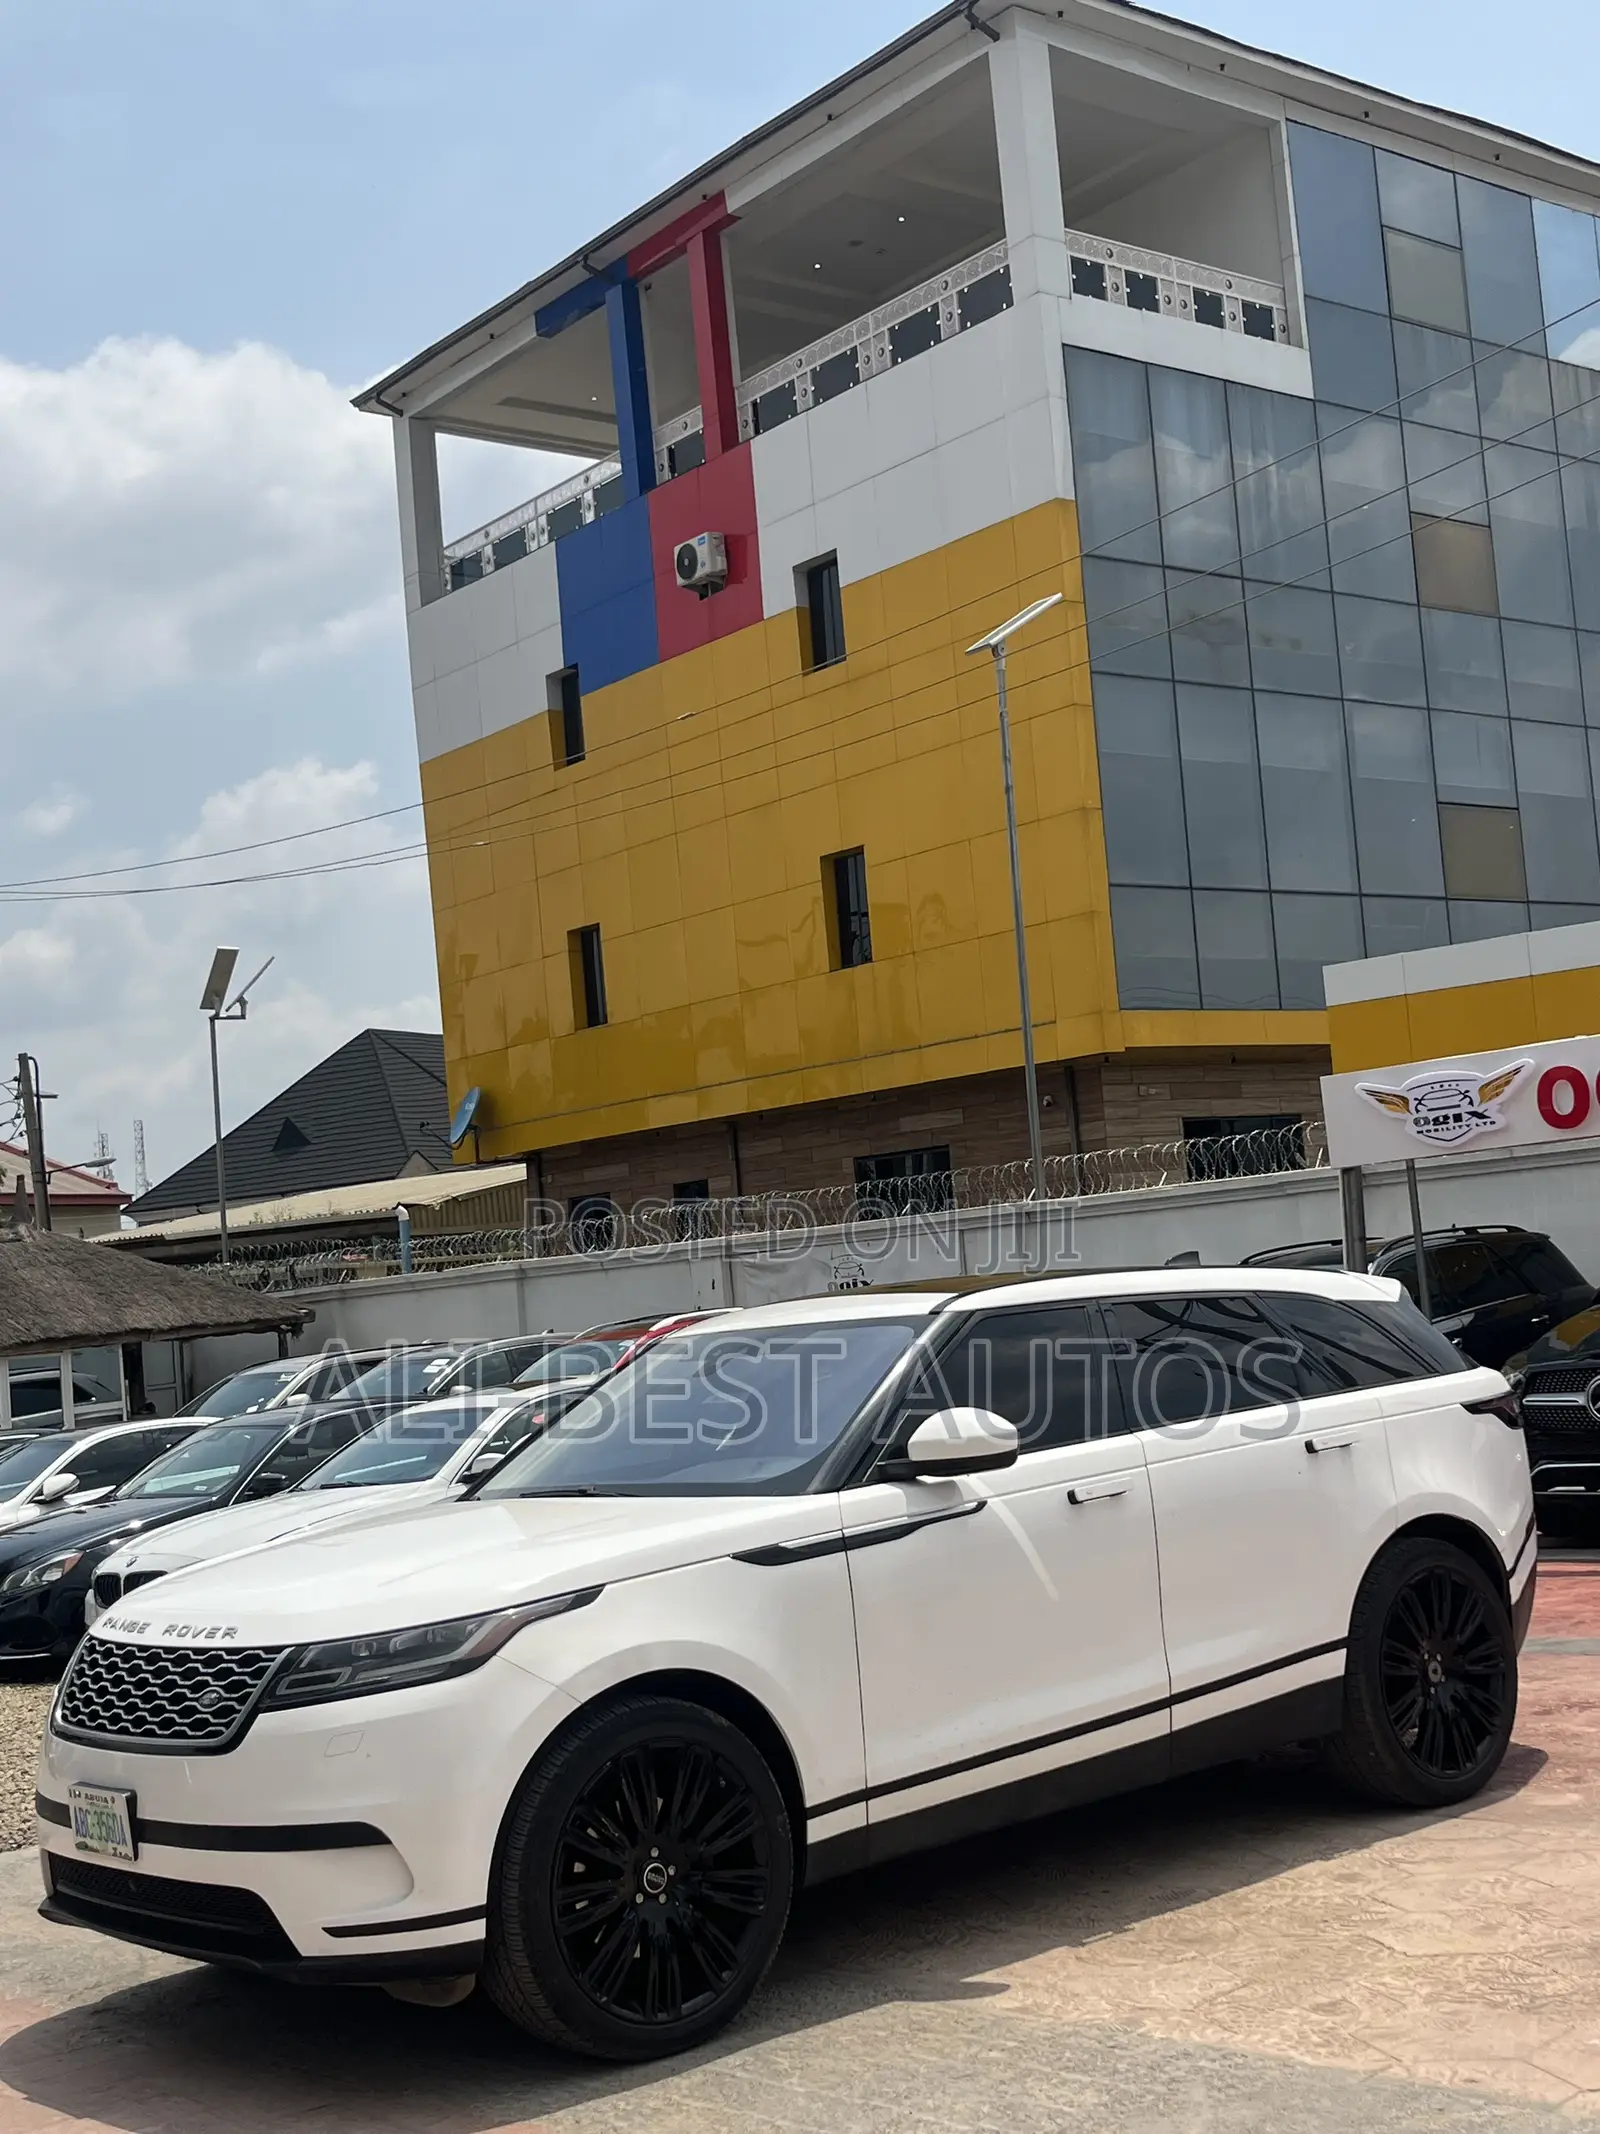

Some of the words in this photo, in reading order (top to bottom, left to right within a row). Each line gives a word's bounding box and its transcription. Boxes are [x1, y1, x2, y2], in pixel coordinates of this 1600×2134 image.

[1536, 1065, 1600, 1130] O
[1416, 1123, 1471, 1134] MOBILITY
[1475, 1120, 1496, 1128] LTD
[102, 1616, 151, 1634] RANGE
[162, 1623, 239, 1640] ROVER
